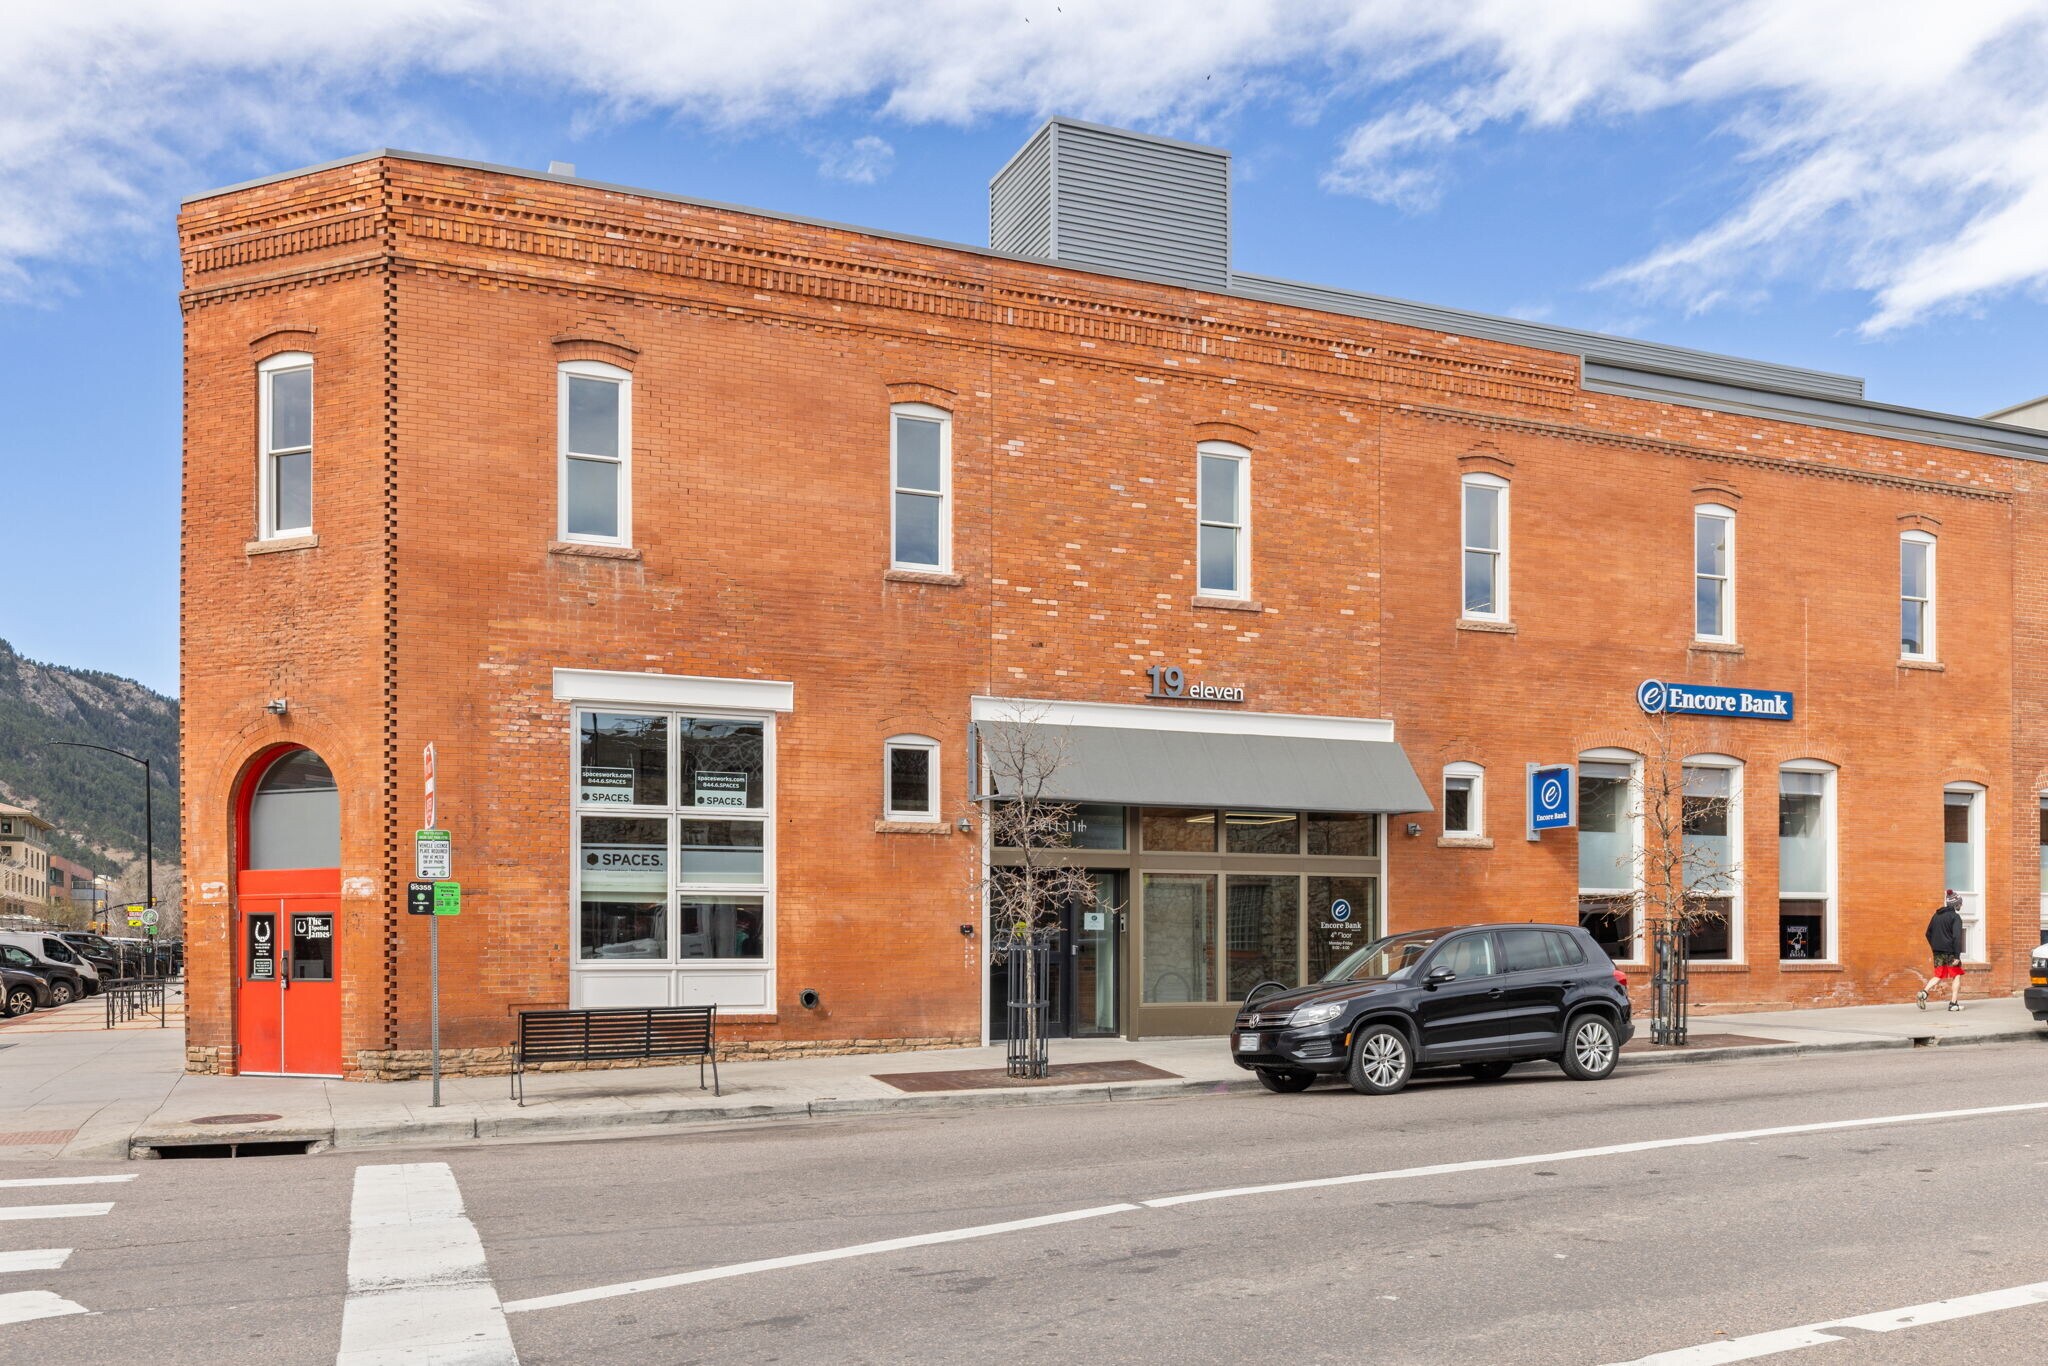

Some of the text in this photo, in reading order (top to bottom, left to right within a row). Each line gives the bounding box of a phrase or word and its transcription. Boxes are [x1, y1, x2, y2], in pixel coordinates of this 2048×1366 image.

[1146, 664, 1244, 700] 19 eleven
[1669, 688, 1788, 715] Encore Bank
[592, 793, 632, 803] SPACES.
[706, 796, 745, 806] SPACES.
[1536, 811, 1568, 822] Encore Bank
[1065, 819, 1087, 833] 11th
[602, 853, 663, 867] SPACES.
[307, 917, 322, 925] The
[306, 926, 329, 939] James
